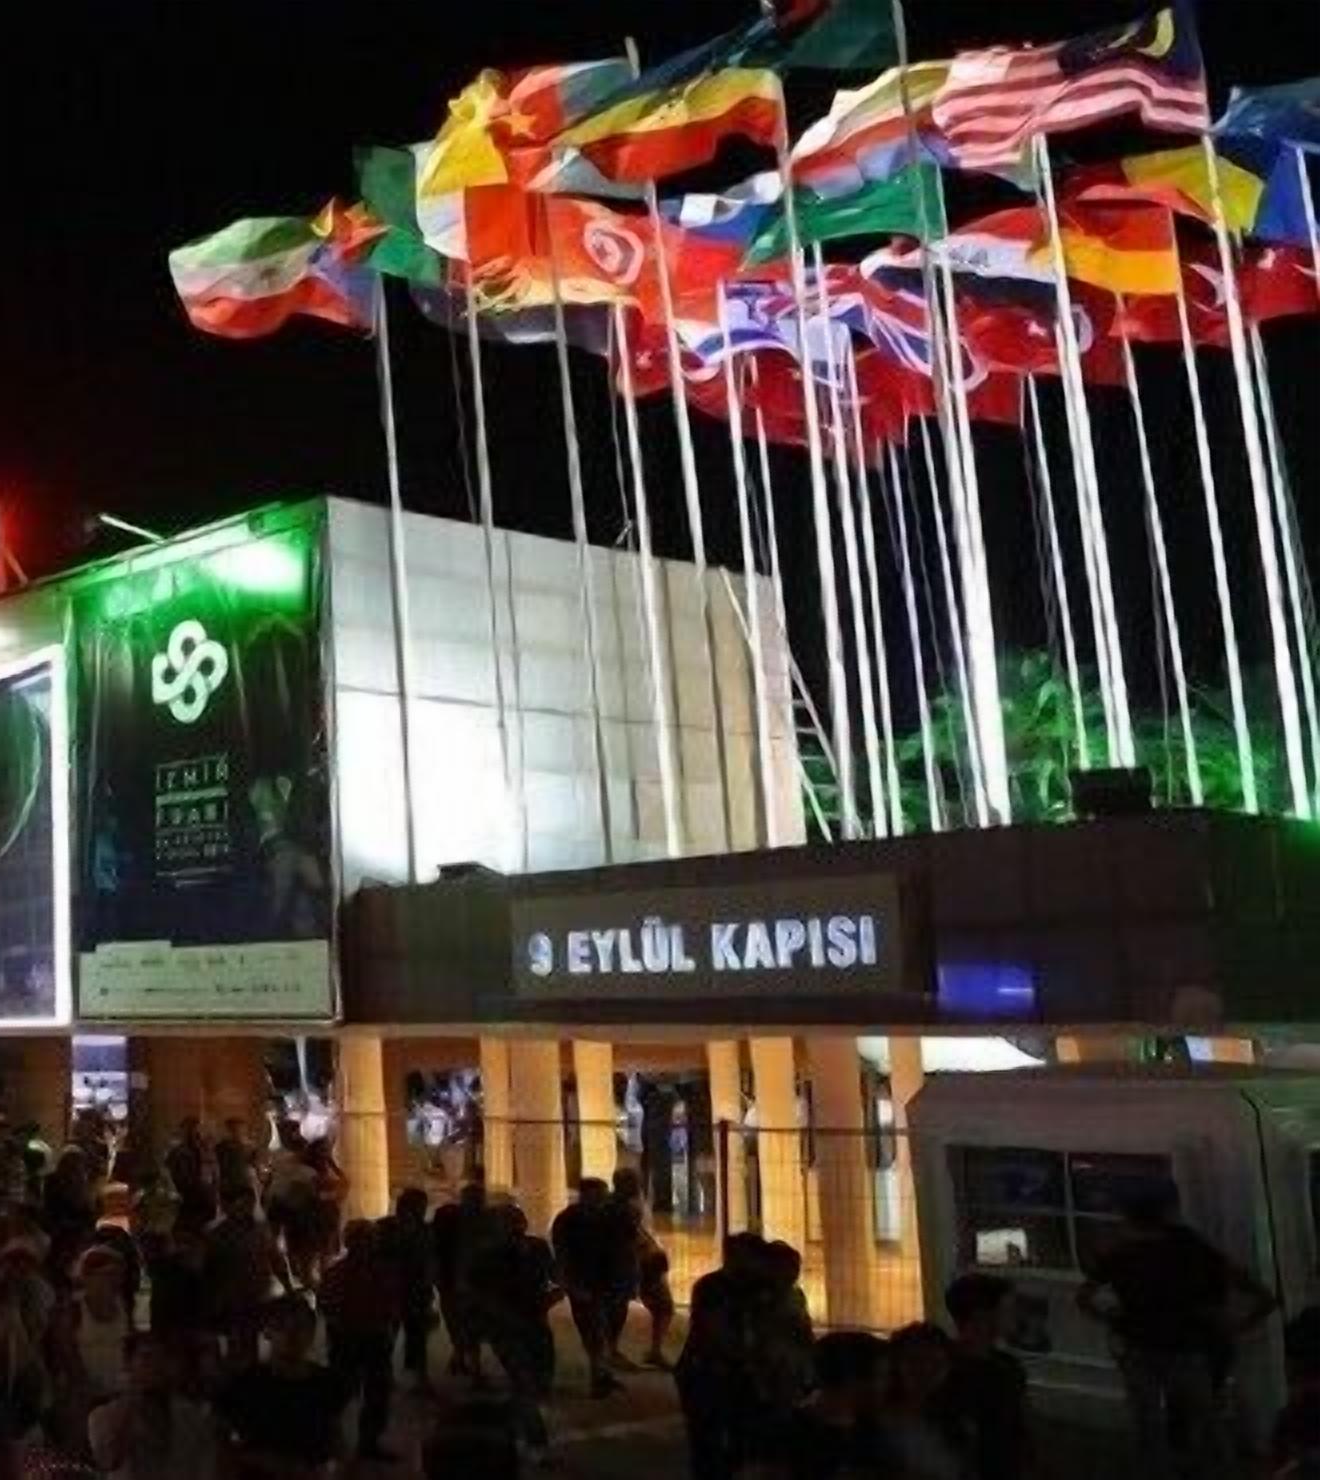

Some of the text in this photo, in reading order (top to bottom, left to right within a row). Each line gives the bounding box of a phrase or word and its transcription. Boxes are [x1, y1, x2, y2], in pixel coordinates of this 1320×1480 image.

[527, 914, 878, 977] 9 EYLÜL KAPISI
